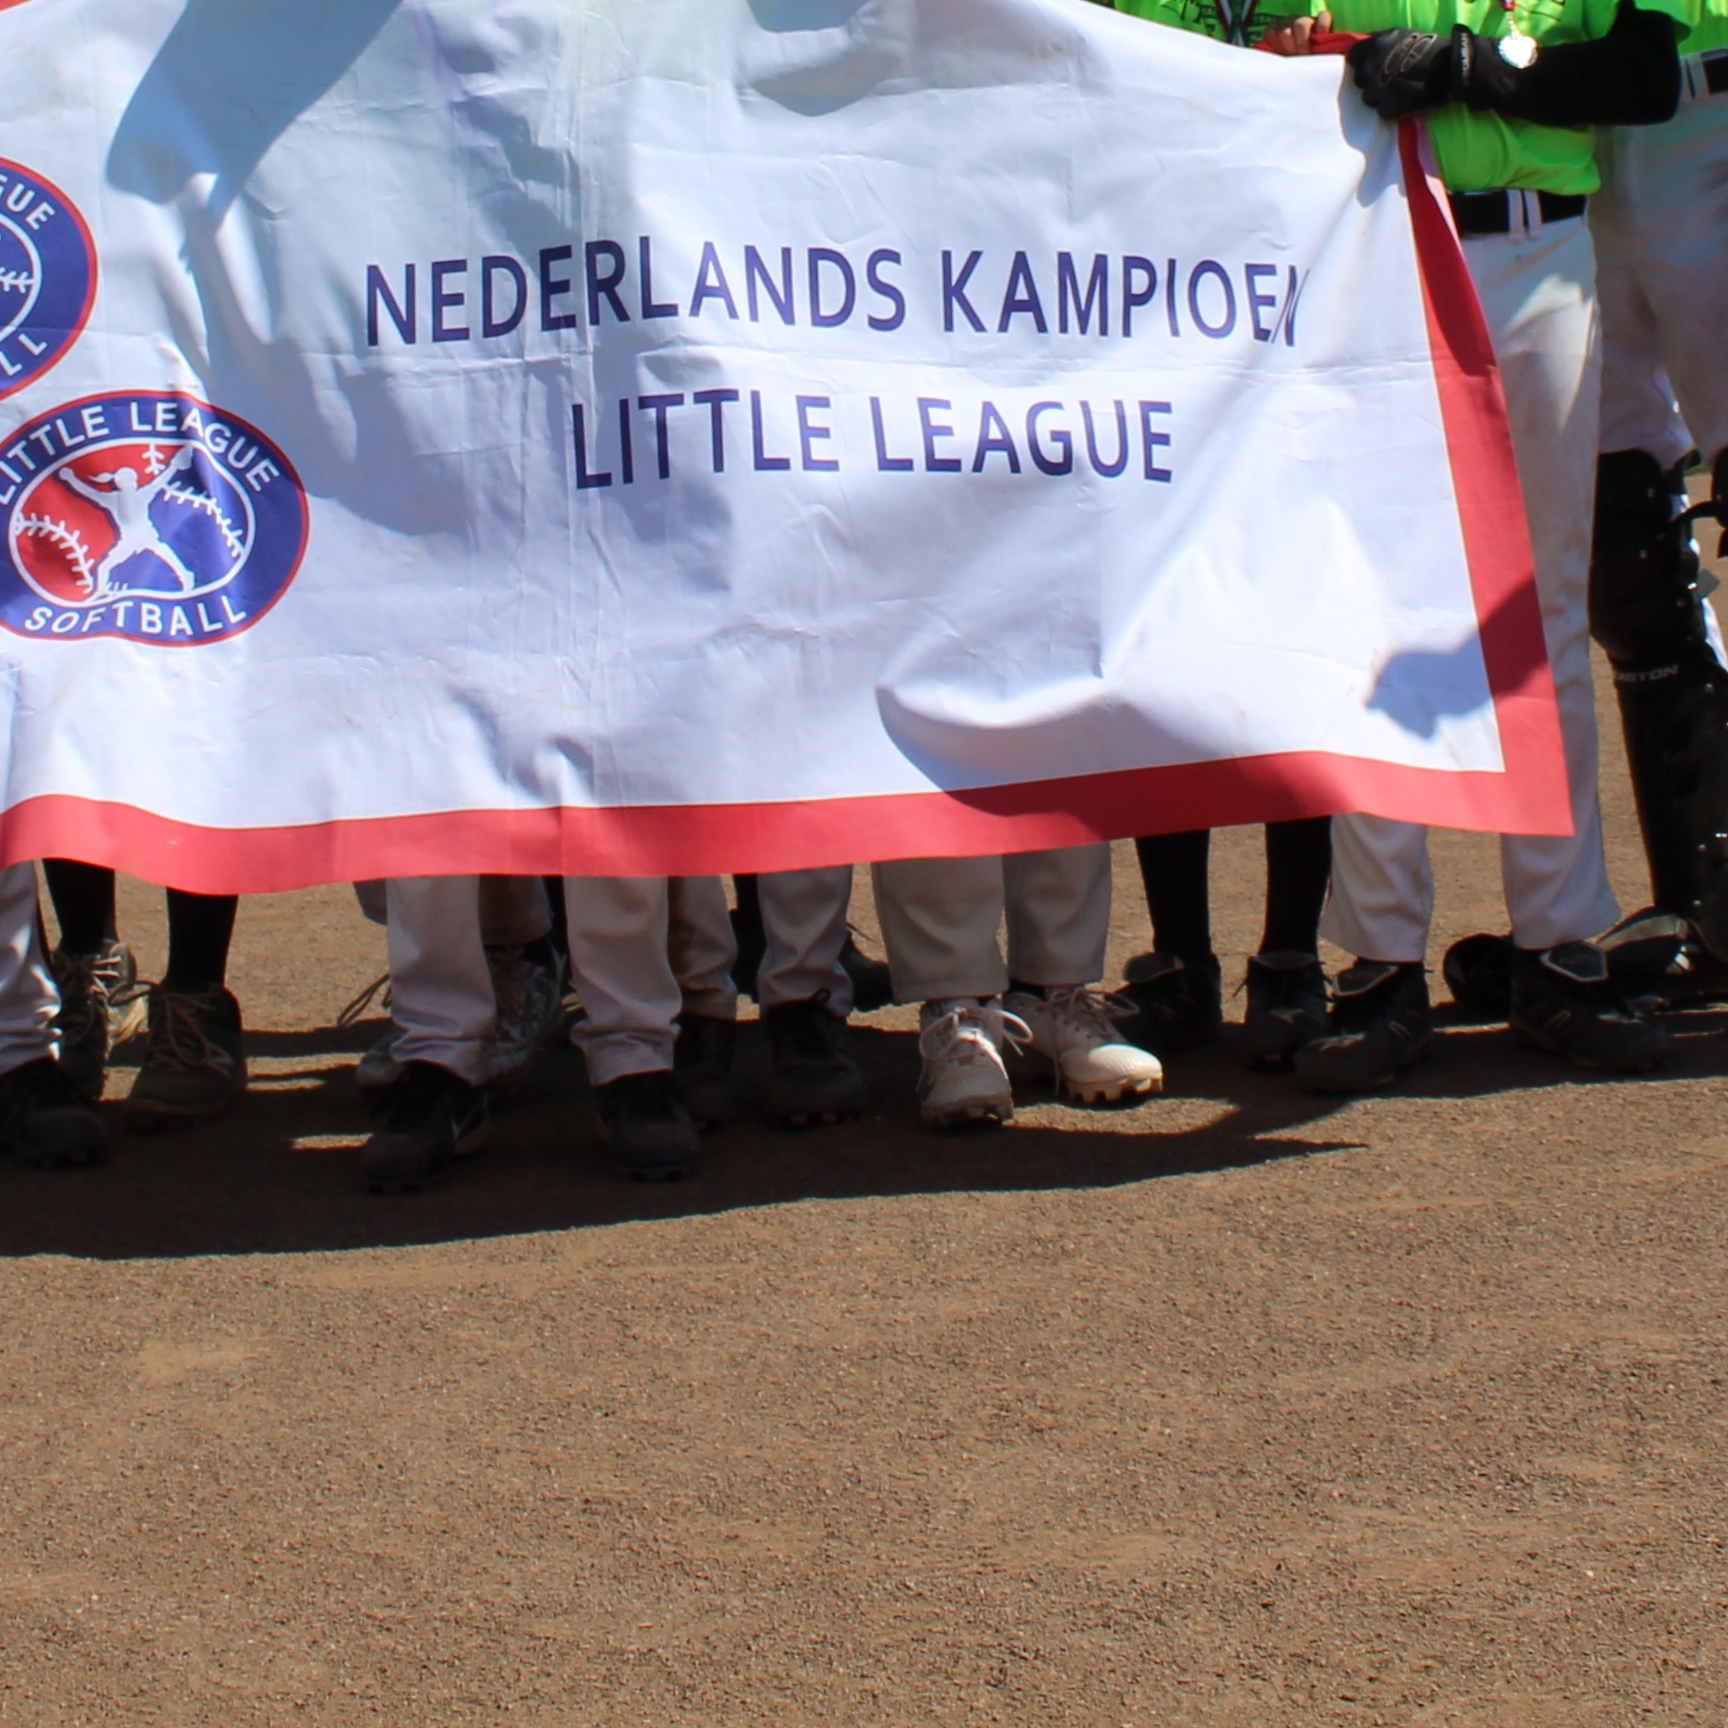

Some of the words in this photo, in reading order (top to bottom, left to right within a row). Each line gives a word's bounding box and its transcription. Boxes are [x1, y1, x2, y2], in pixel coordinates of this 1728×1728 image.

[366, 235, 908, 348] NEDERLANDS
[130, 402, 280, 492] LEAGUE
[573, 388, 840, 489] LITTLE
[872, 395, 1173, 482] LEAGUE
[24, 594, 247, 637] SOFTBALL
